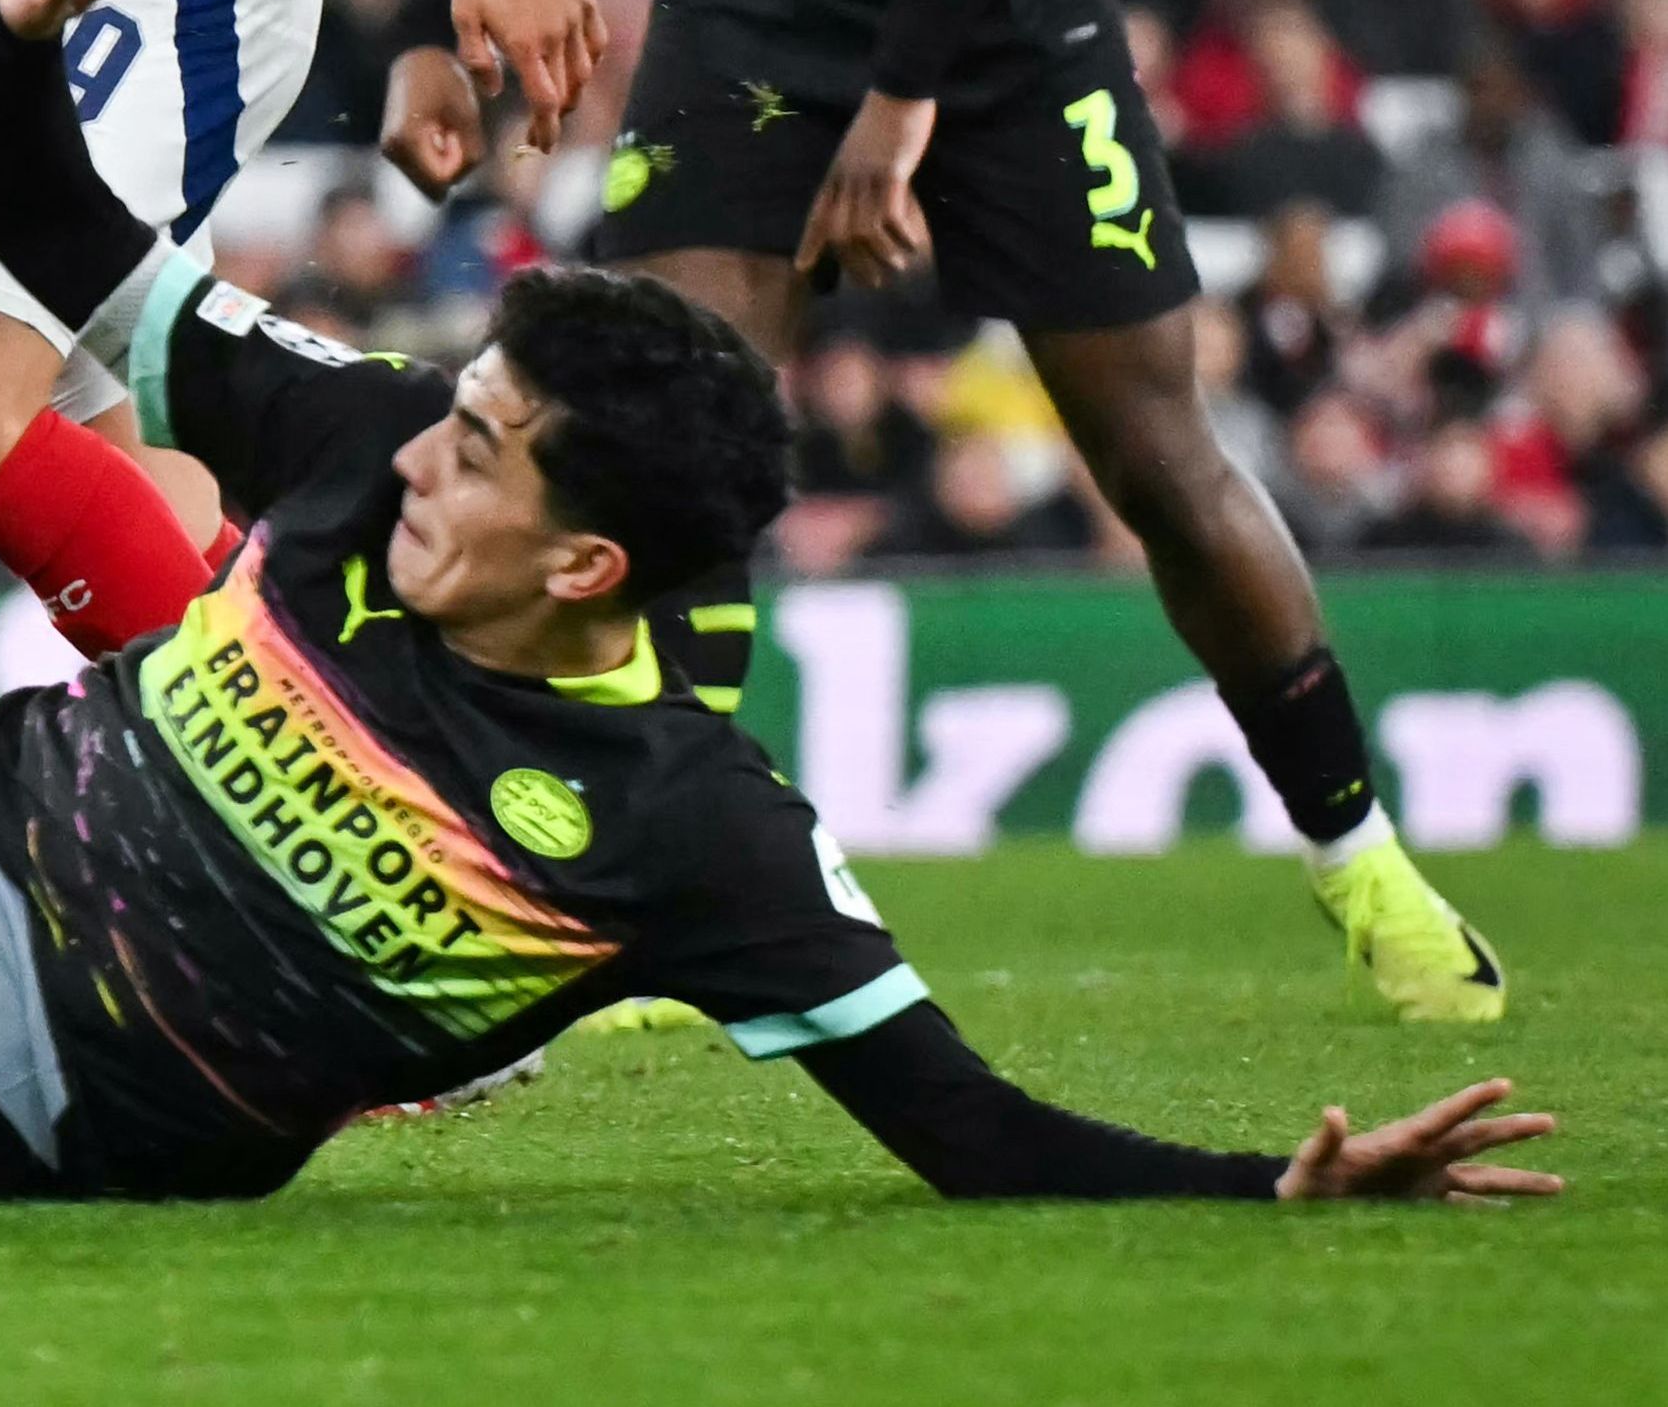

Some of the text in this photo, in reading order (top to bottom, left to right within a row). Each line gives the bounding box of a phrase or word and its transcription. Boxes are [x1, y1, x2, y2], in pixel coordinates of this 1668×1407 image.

[1063, 88, 1139, 221] 3
[163, 667, 423, 980] EINDHOVEN
[206, 638, 484, 948] BRAINPORT
